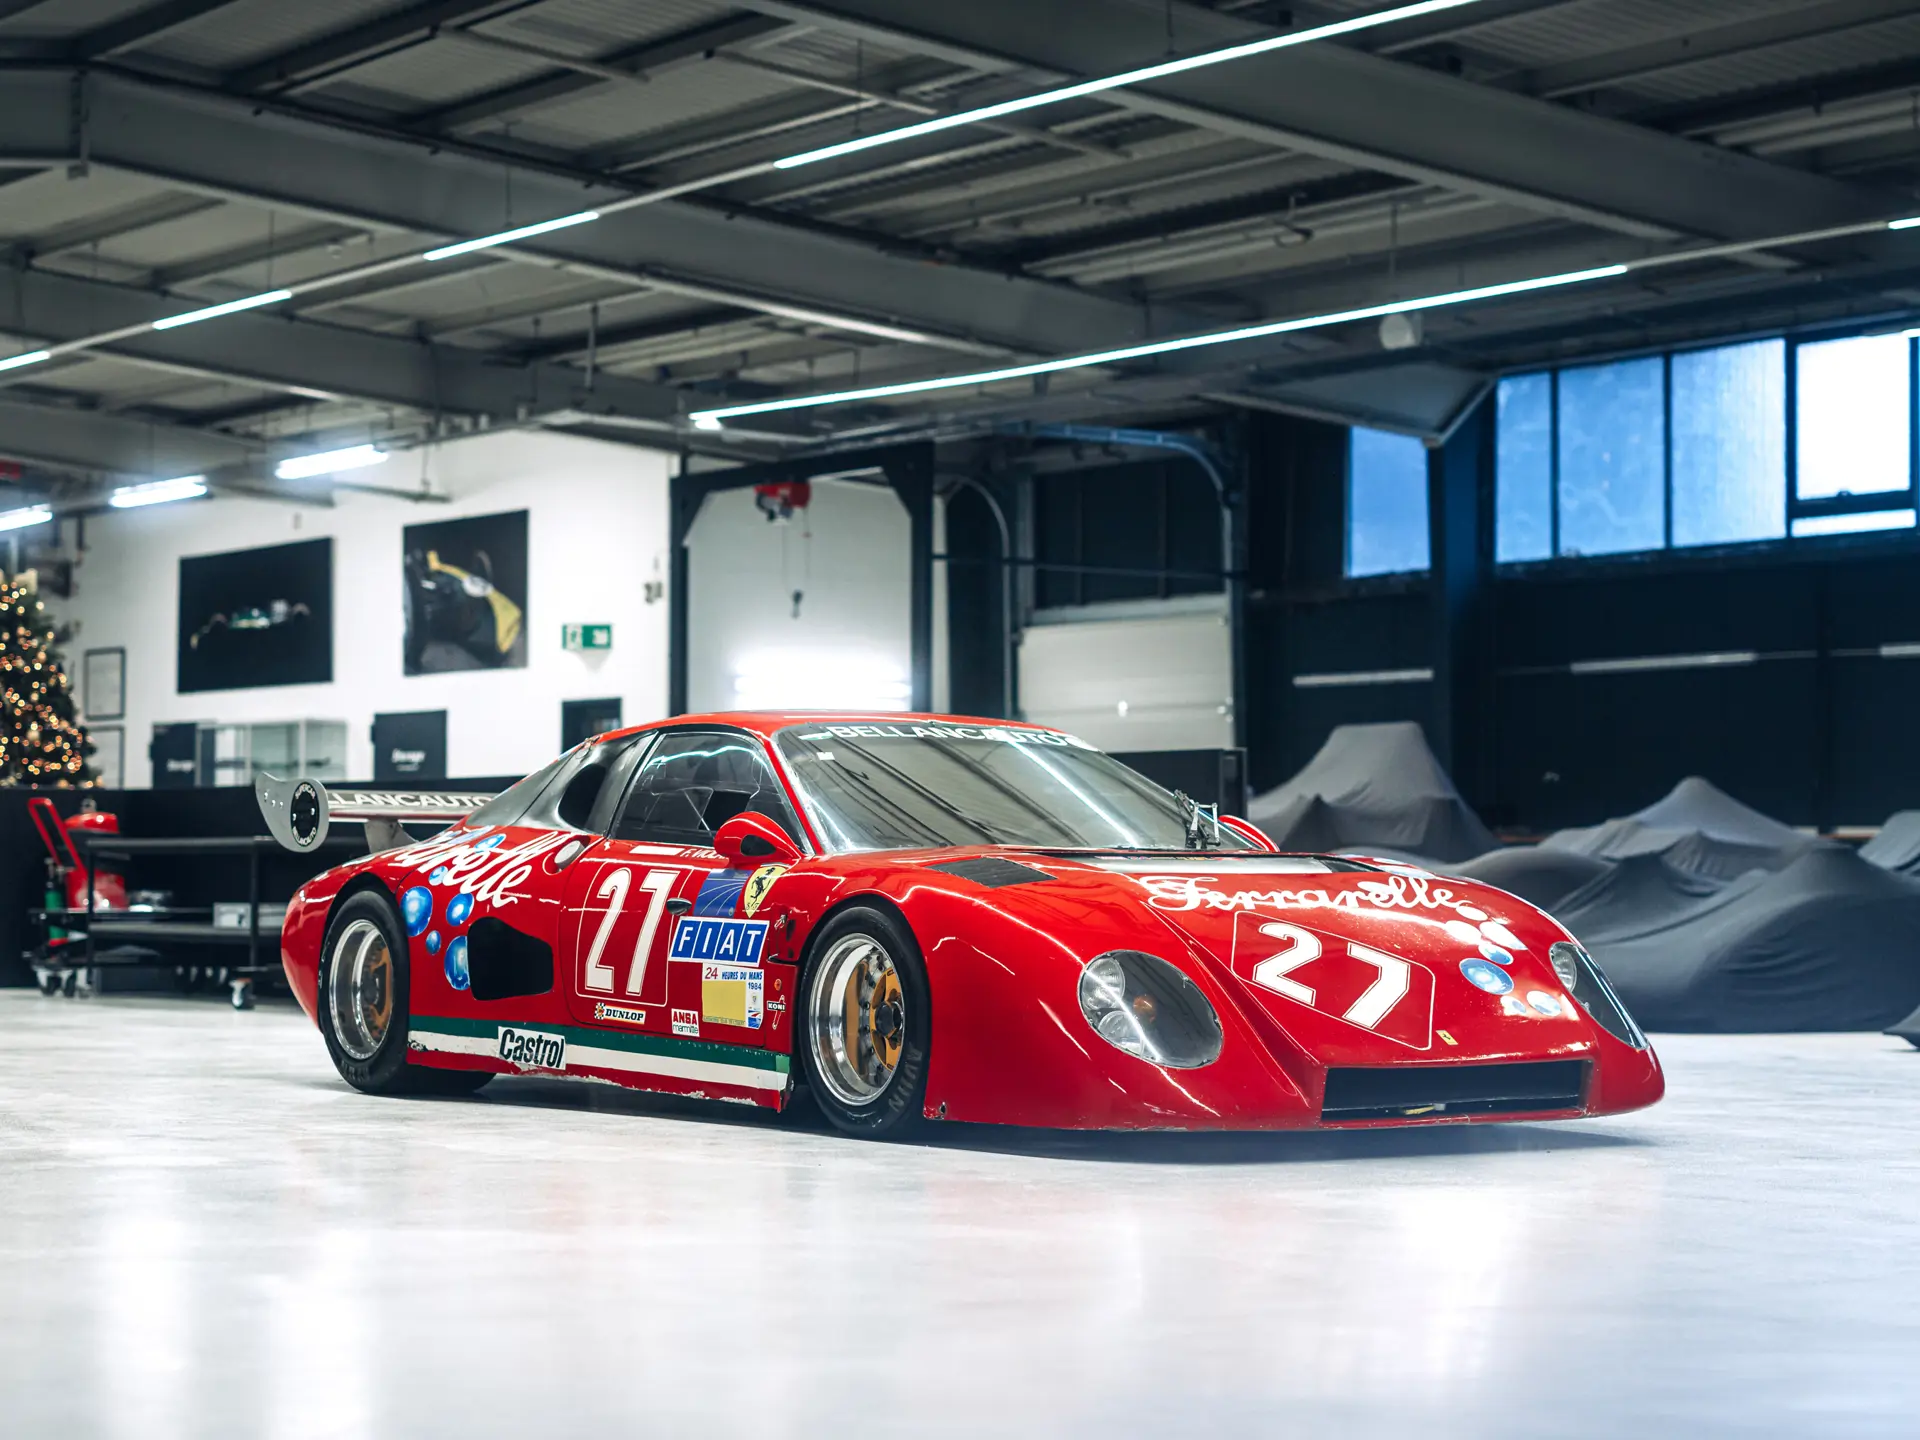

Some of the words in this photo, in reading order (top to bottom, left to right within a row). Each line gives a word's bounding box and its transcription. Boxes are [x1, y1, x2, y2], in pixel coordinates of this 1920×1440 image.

[826, 725, 1067, 747] BELLANCAUTO
[1139, 875, 1466, 911] Ferrarelle
[585, 867, 681, 996] 27
[678, 927, 761, 957] FIAT
[705, 967, 718, 980] 24
[721, 971, 738, 980] HEURES
[740, 971, 747, 980] DU
[748, 971, 762, 980] MANS
[1253, 922, 1411, 1029] 27
[748, 982, 762, 990] 1984
[605, 1008, 644, 1021] DUNLOP
[768, 1002, 785, 1010] KONI
[673, 1011, 697, 1025] ANSA
[500, 1028, 564, 1068] Castrol
